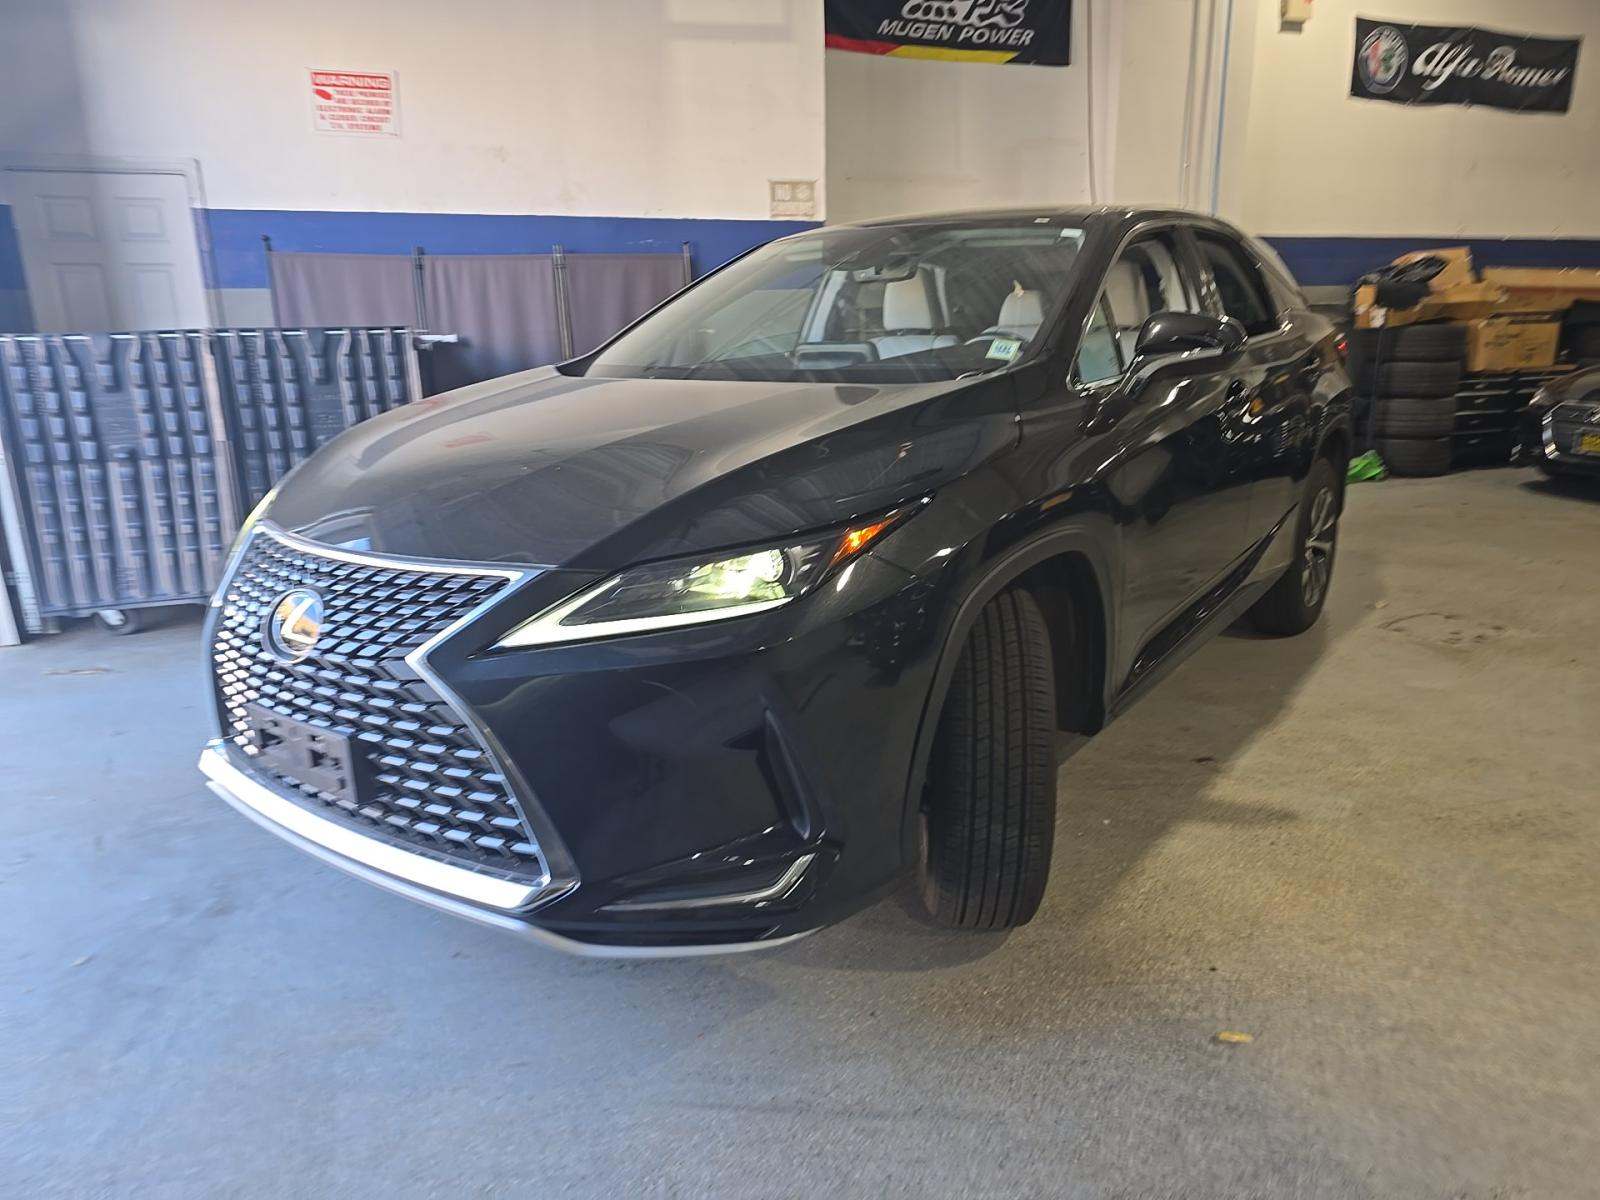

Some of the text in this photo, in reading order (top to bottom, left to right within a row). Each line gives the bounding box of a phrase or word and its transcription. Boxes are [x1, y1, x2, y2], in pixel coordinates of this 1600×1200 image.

[876, 19, 1035, 46] MUGEN POWER
[1411, 41, 1484, 91] Alfa
